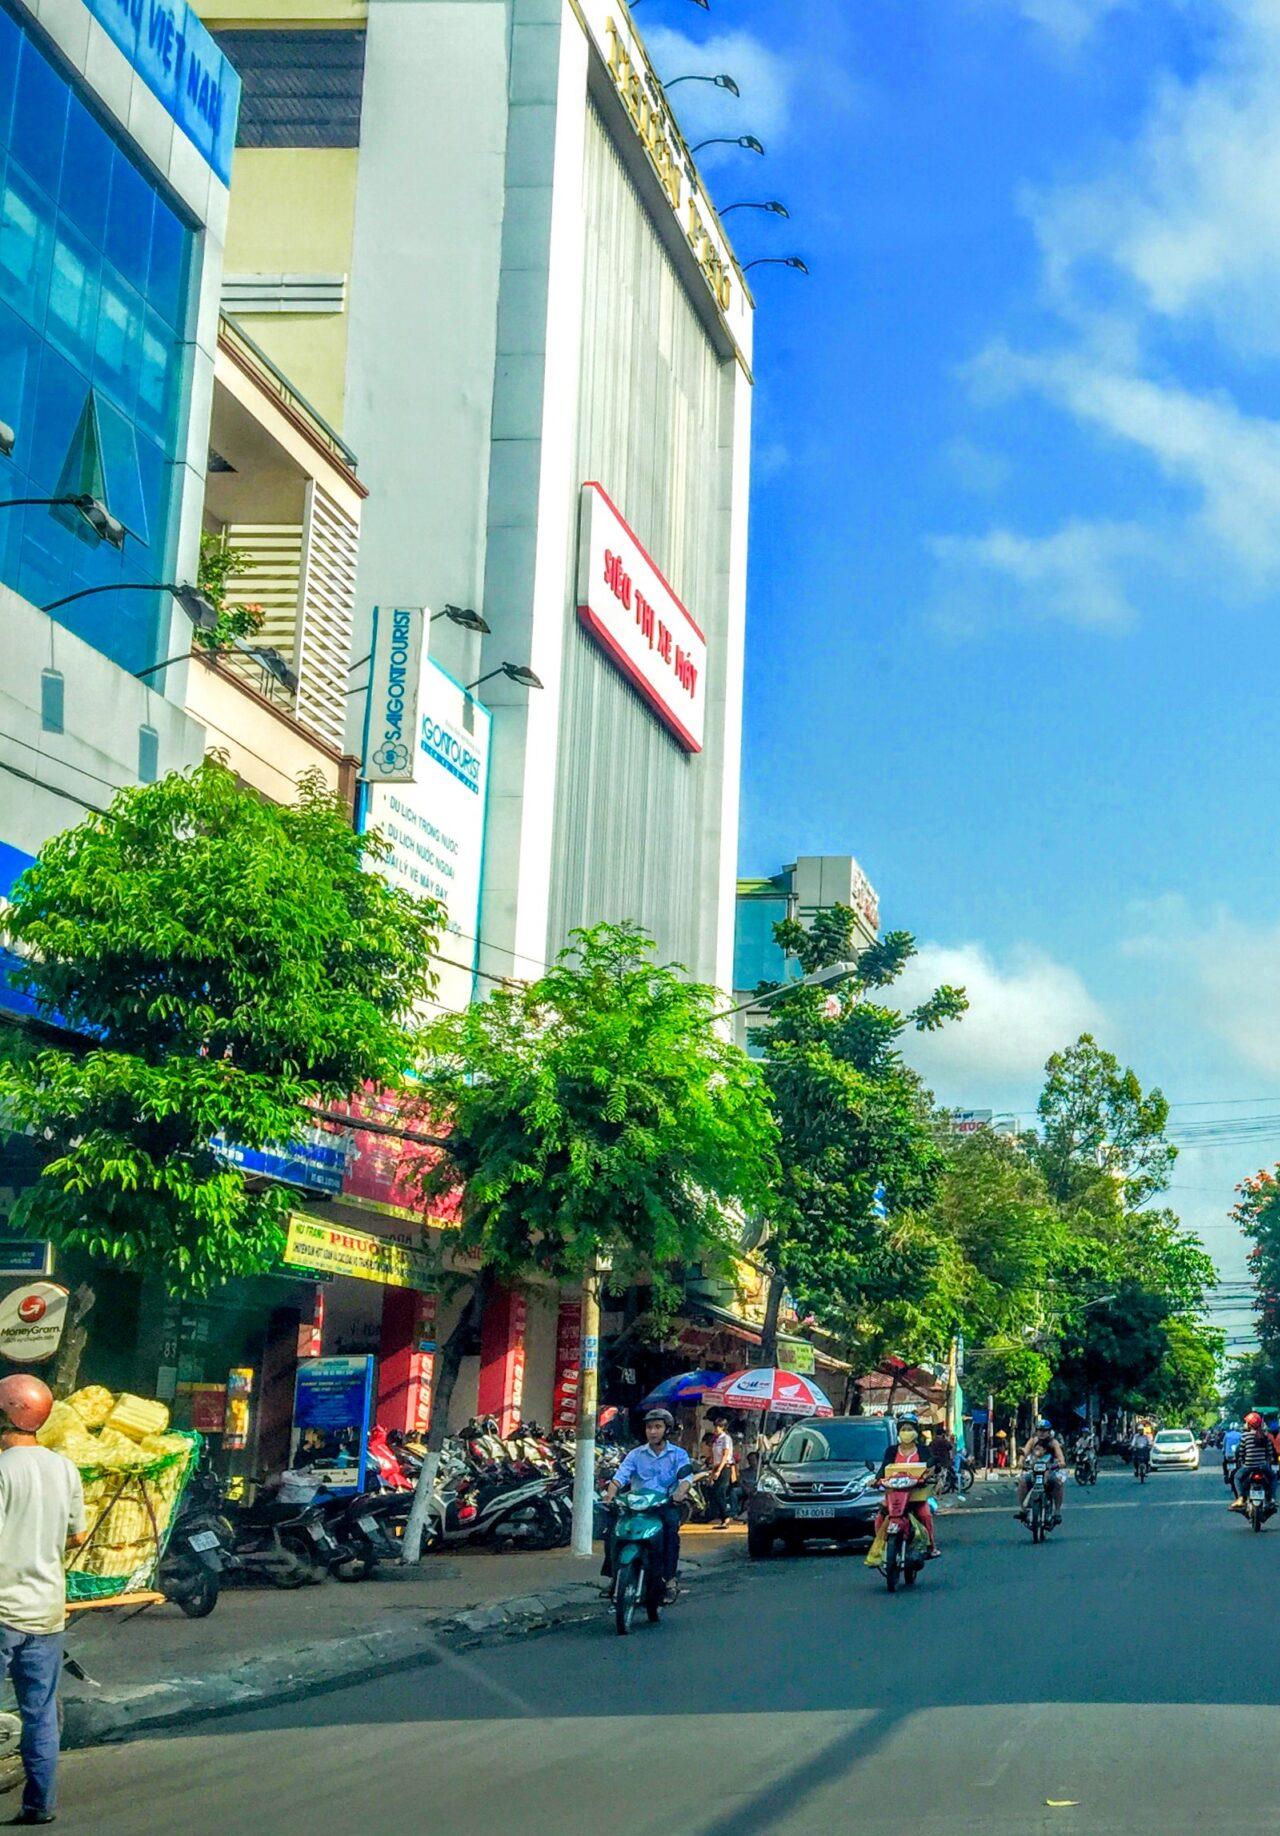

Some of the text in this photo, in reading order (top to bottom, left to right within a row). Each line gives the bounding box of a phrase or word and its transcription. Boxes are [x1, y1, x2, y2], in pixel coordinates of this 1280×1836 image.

[186, 50, 224, 137] NAM
[604, 548, 698, 699] SIÊU THỊ XE MÁY
[384, 608, 411, 741] SAIGONTOURIST
[422, 712, 481, 780] IGONTOURIST
[1, 1325, 60, 1336] MoneyGram
